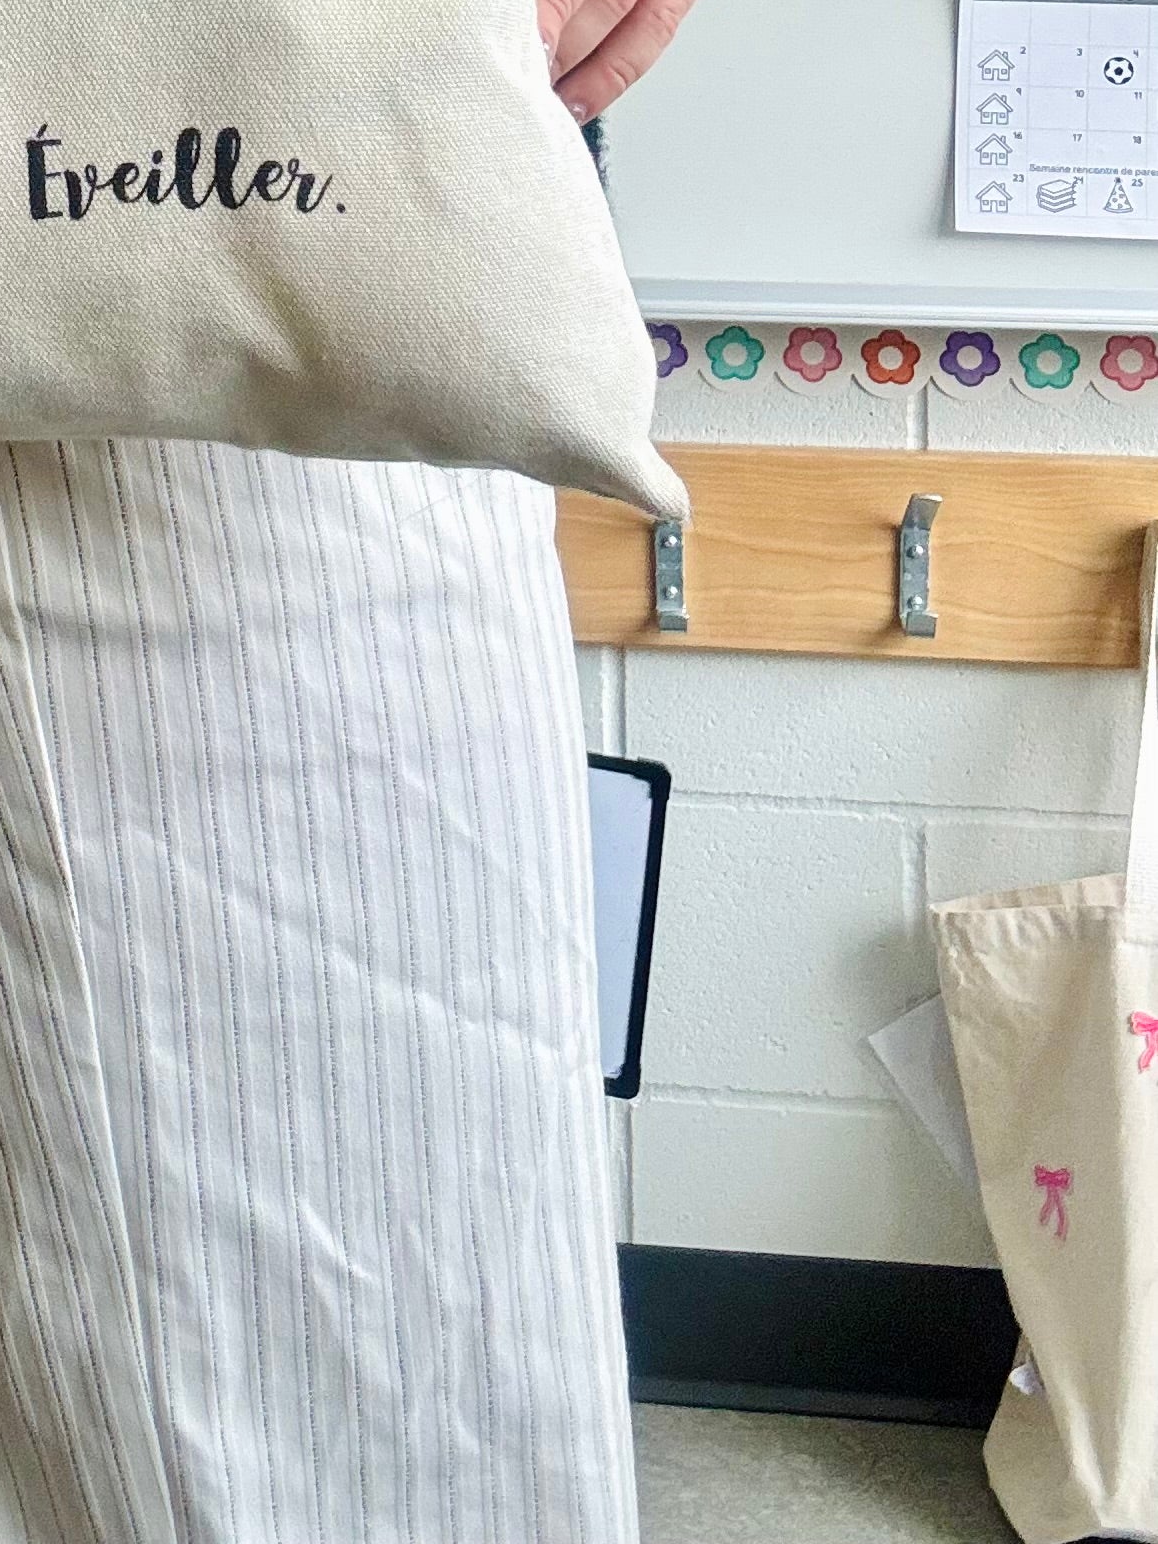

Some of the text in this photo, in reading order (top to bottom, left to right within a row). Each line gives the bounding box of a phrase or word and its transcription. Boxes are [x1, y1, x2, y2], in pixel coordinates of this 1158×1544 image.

[25, 123, 347, 221] Éveiller.
[1012, 173, 1025, 183] 23
[1131, 178, 1143, 188] 25
